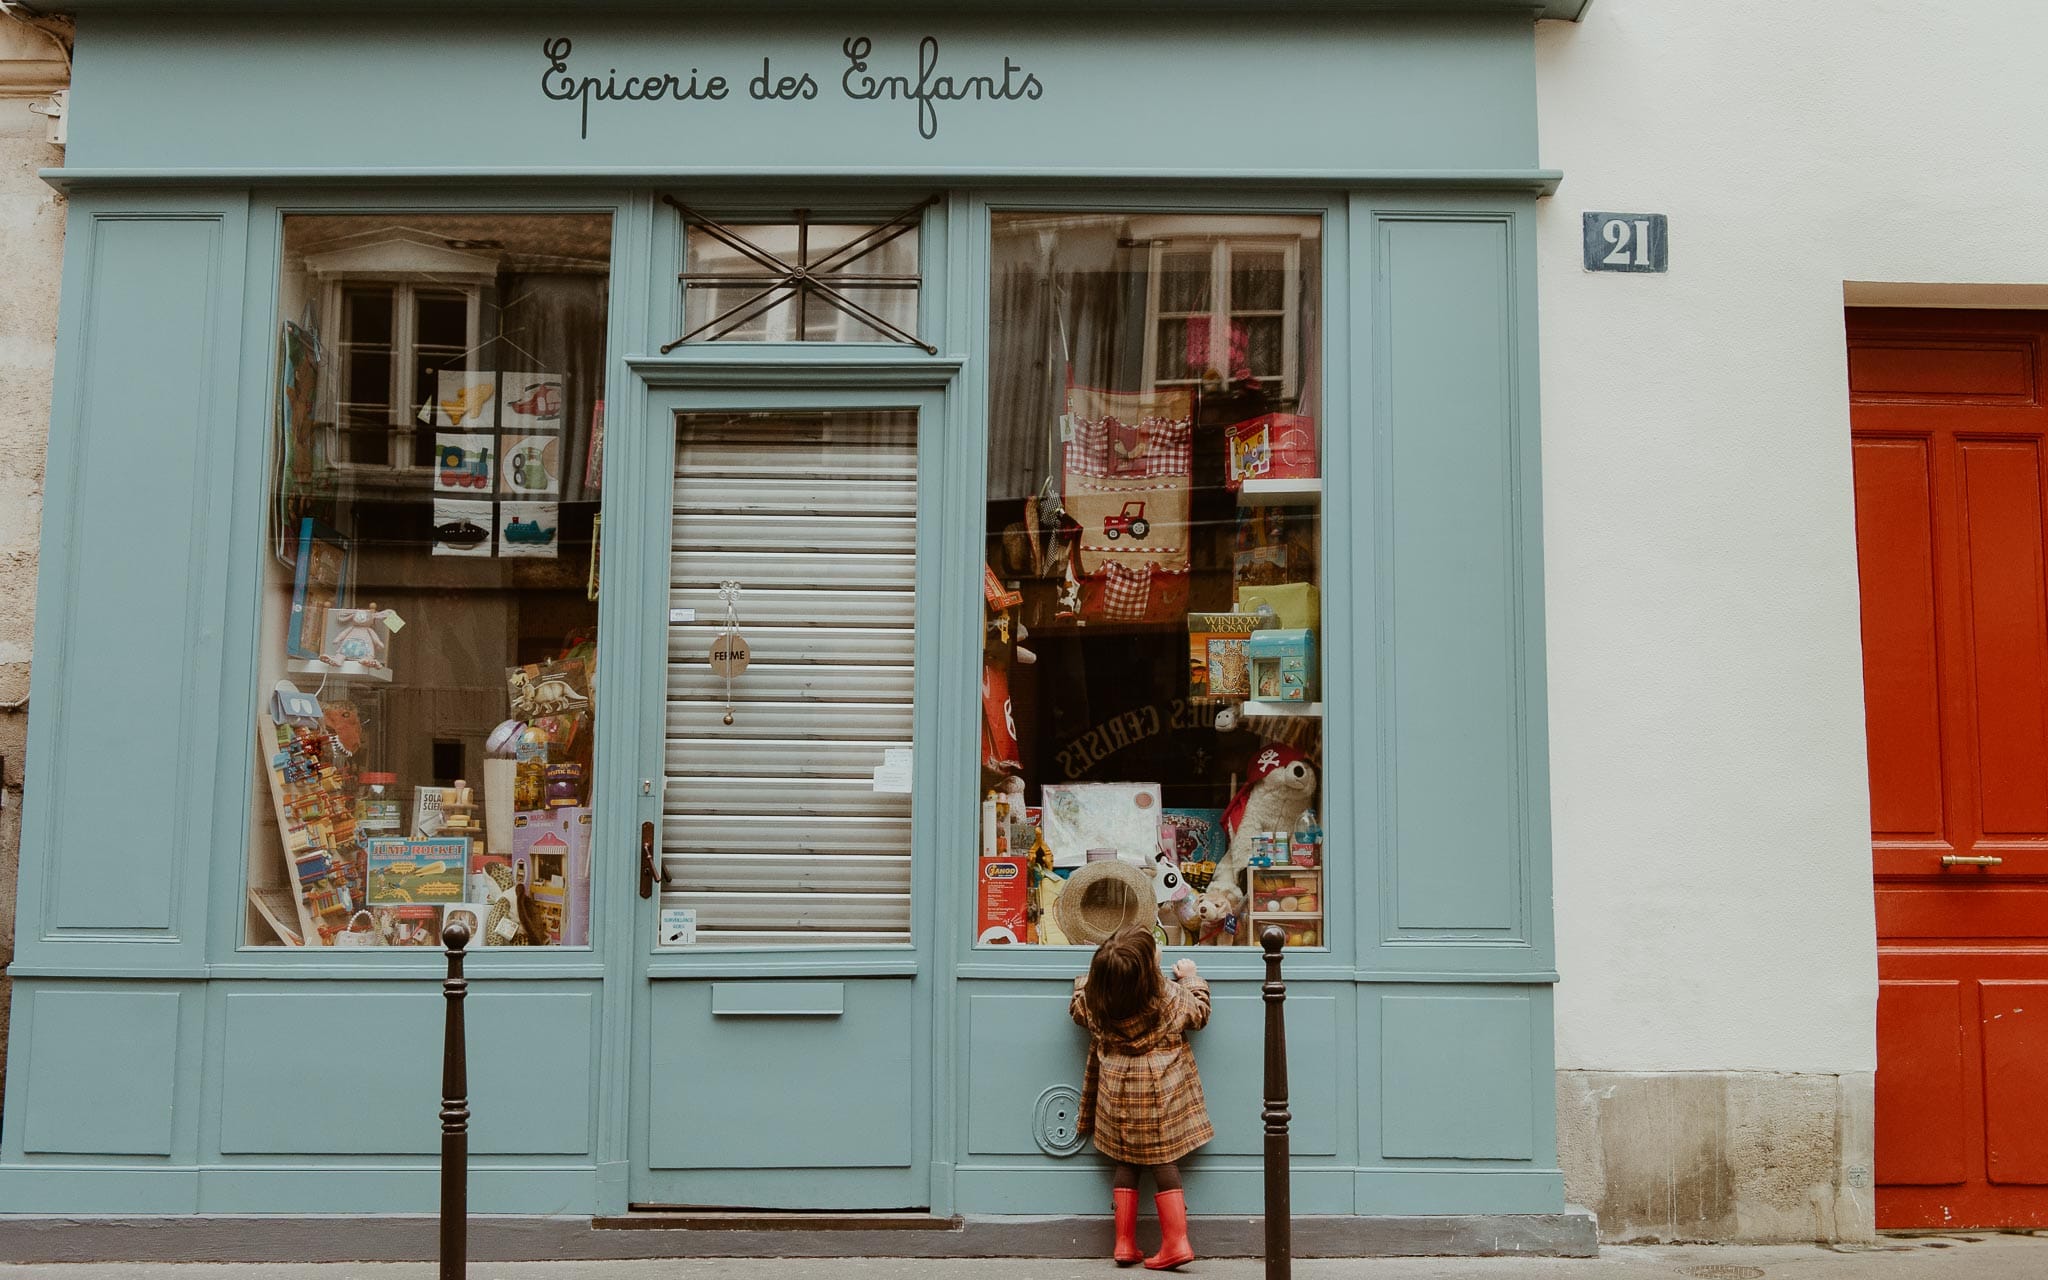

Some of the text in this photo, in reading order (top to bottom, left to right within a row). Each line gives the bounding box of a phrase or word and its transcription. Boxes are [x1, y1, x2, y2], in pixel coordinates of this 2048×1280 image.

[541, 36, 1044, 140] Epicerie des Enfants
[1602, 219, 1650, 266] 21
[1203, 615, 1262, 625] WINDOW
[1210, 624, 1255, 633] MOSAIC
[373, 845, 464, 855] JUMP ROCKET
